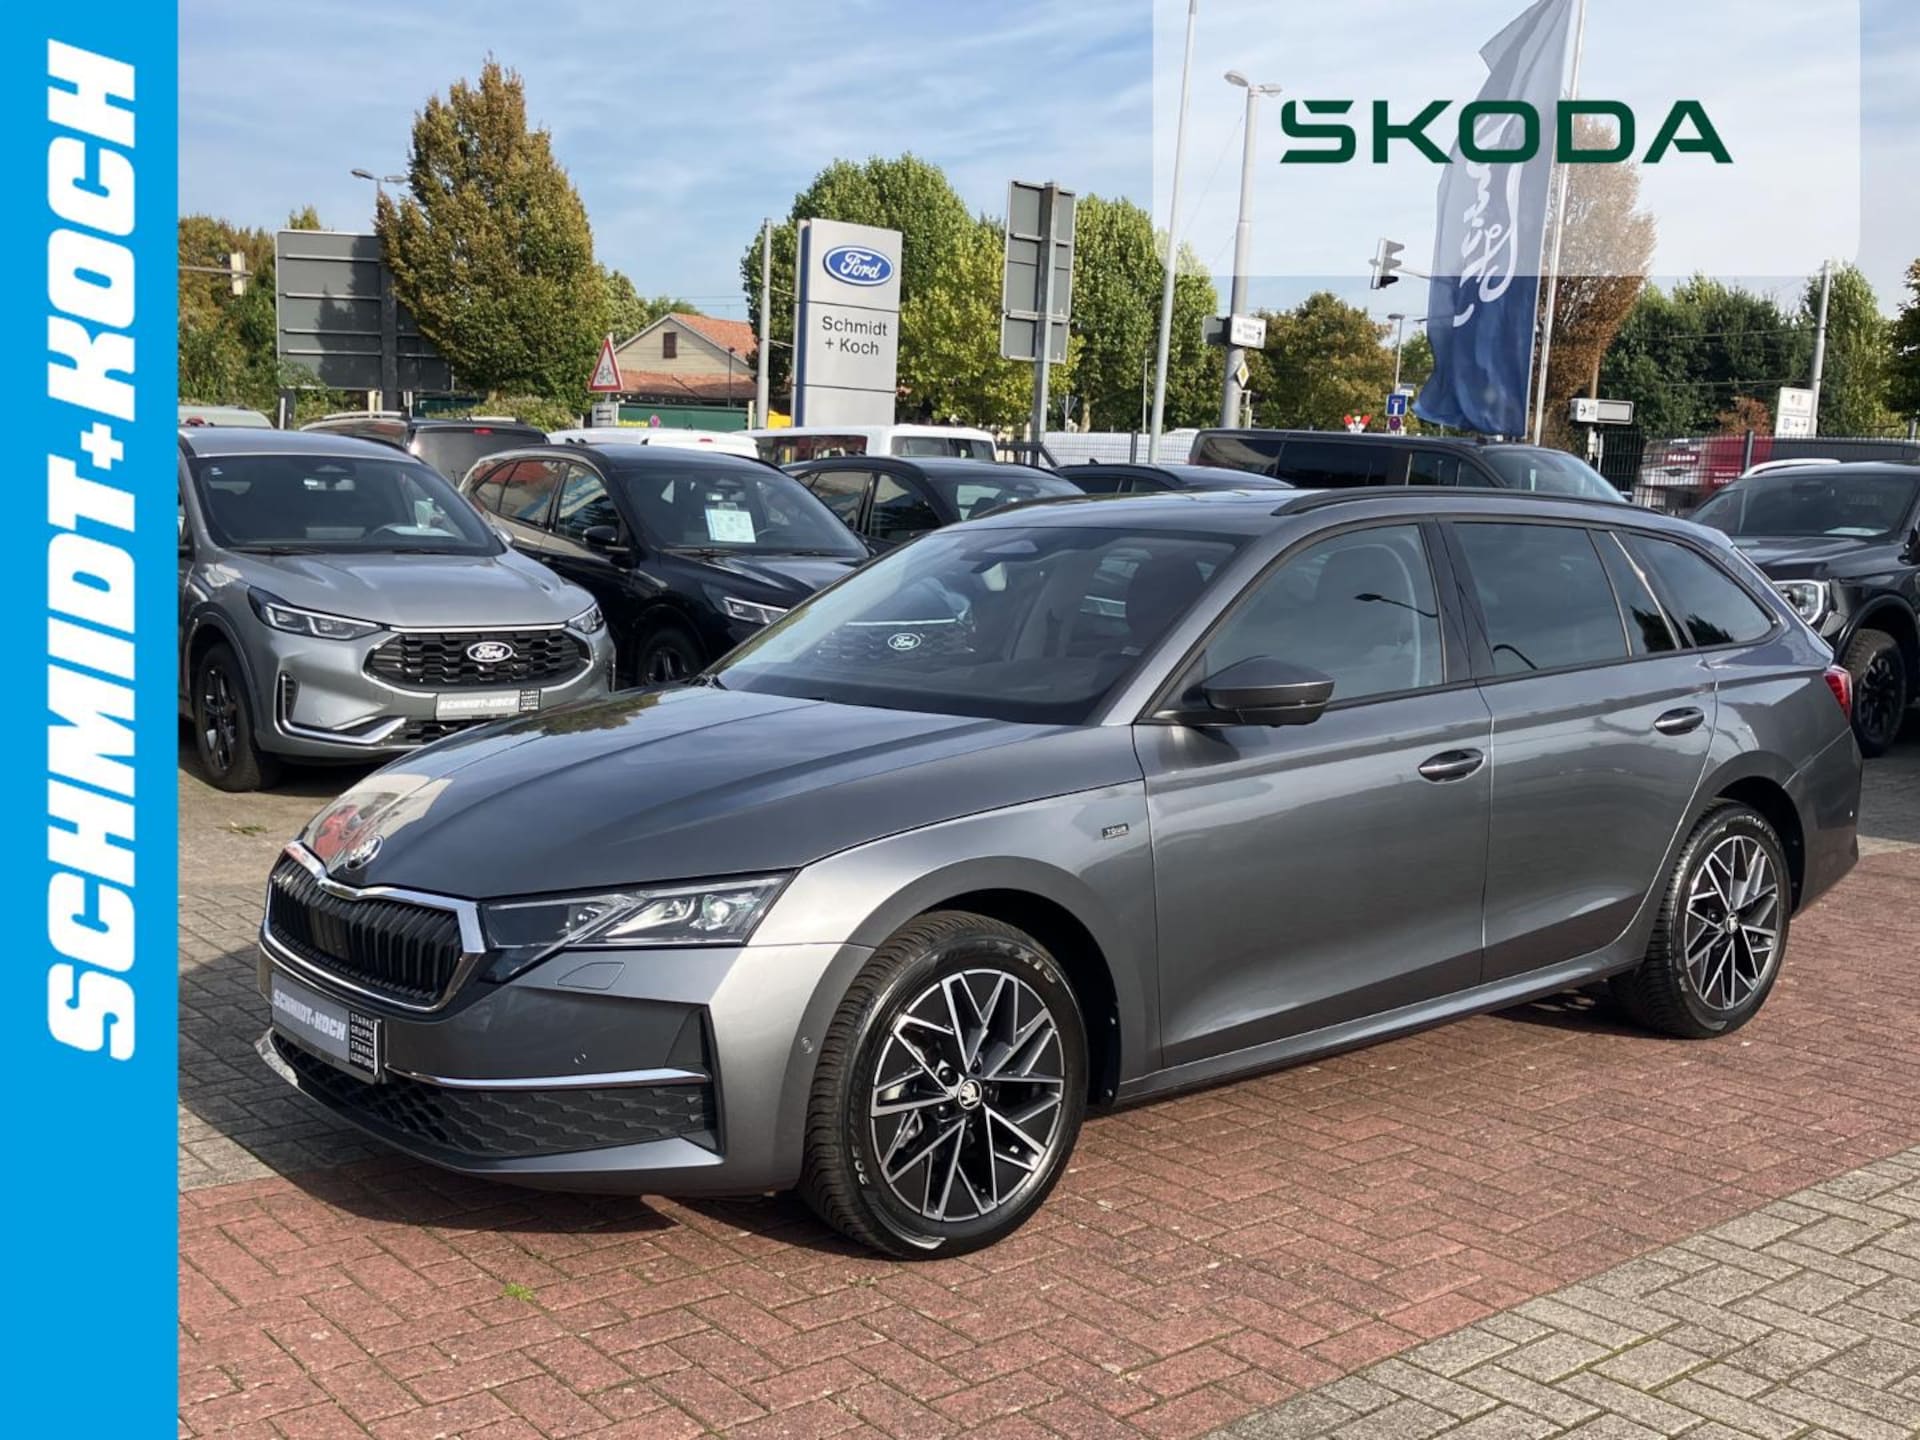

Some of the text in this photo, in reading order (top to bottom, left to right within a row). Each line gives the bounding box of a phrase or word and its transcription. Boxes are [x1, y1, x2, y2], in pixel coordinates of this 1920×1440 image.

[840, 252, 882, 279] Ford
[822, 315, 888, 337] Schmidt
[839, 338, 879, 356] Koch
[474, 643, 507, 660] Ford
